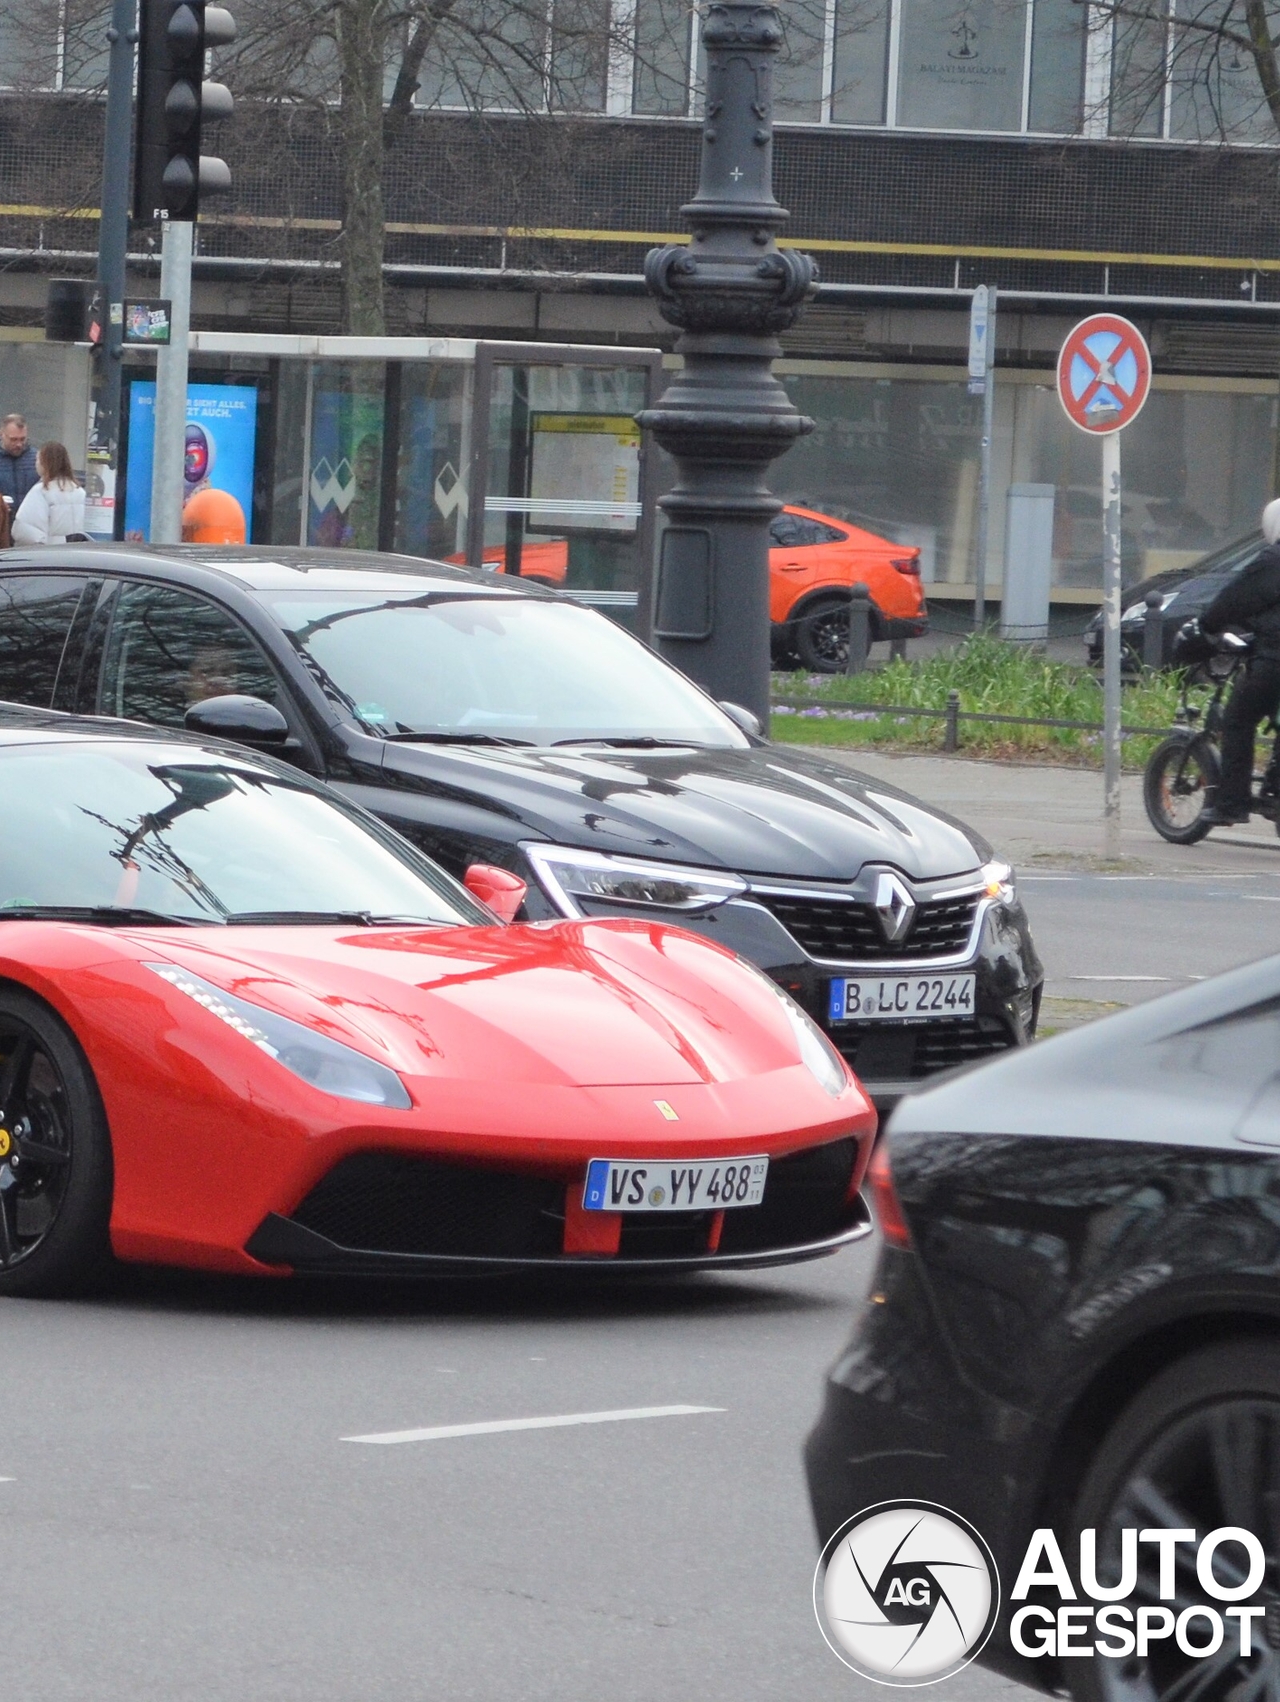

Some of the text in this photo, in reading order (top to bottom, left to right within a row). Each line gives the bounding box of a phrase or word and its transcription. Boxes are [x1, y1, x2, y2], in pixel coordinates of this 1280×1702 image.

[833, 979, 971, 1014] D B LC 2244
[591, 1165, 751, 1205] D VS YY 488
